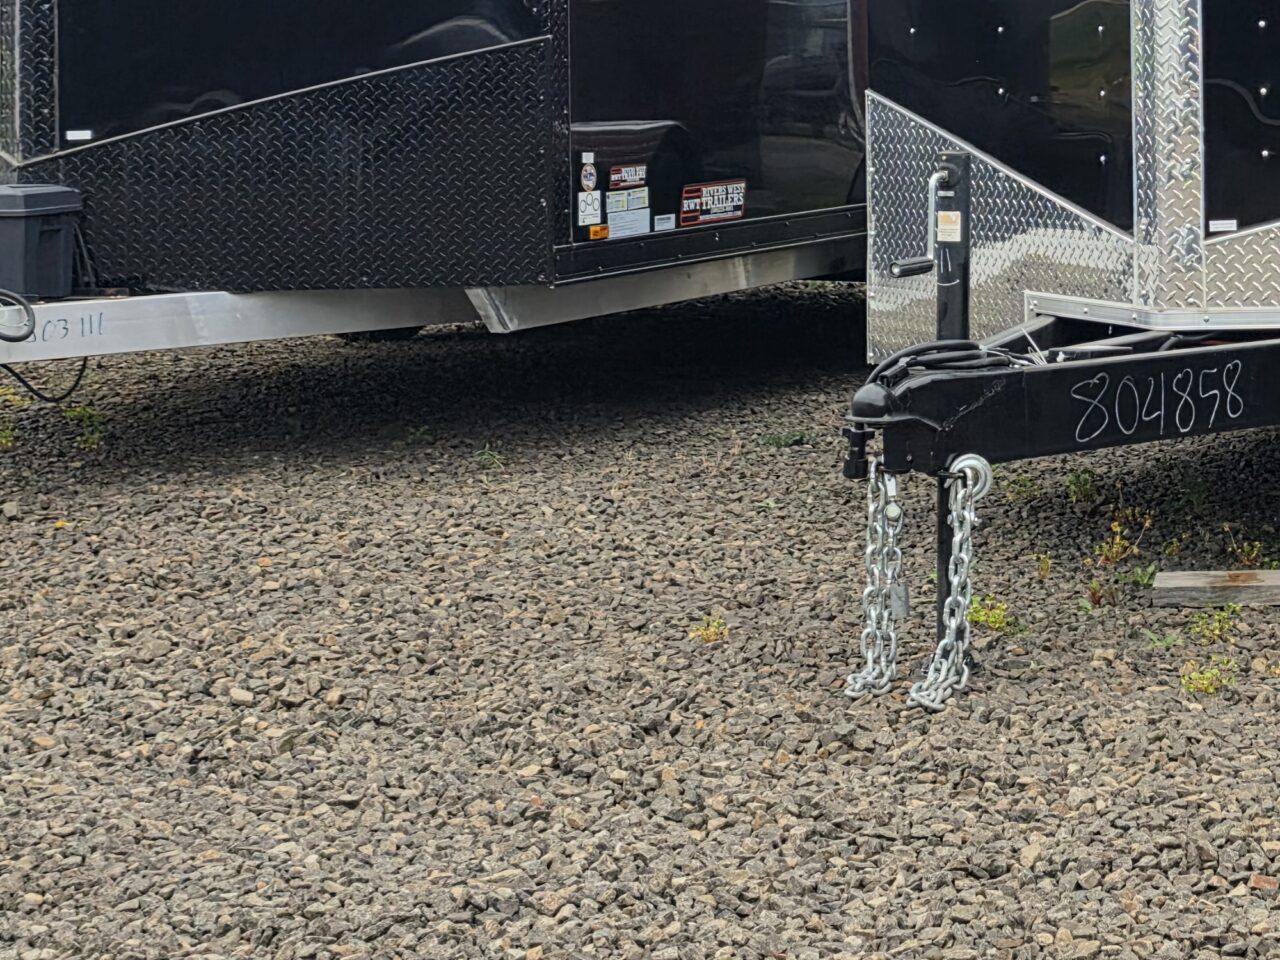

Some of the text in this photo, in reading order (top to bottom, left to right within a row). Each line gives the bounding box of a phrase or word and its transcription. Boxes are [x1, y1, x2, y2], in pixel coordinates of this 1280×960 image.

[683, 199, 700, 211] RWT
[701, 193, 744, 209] TRAILERS
[1070, 359, 1244, 443] 804858
